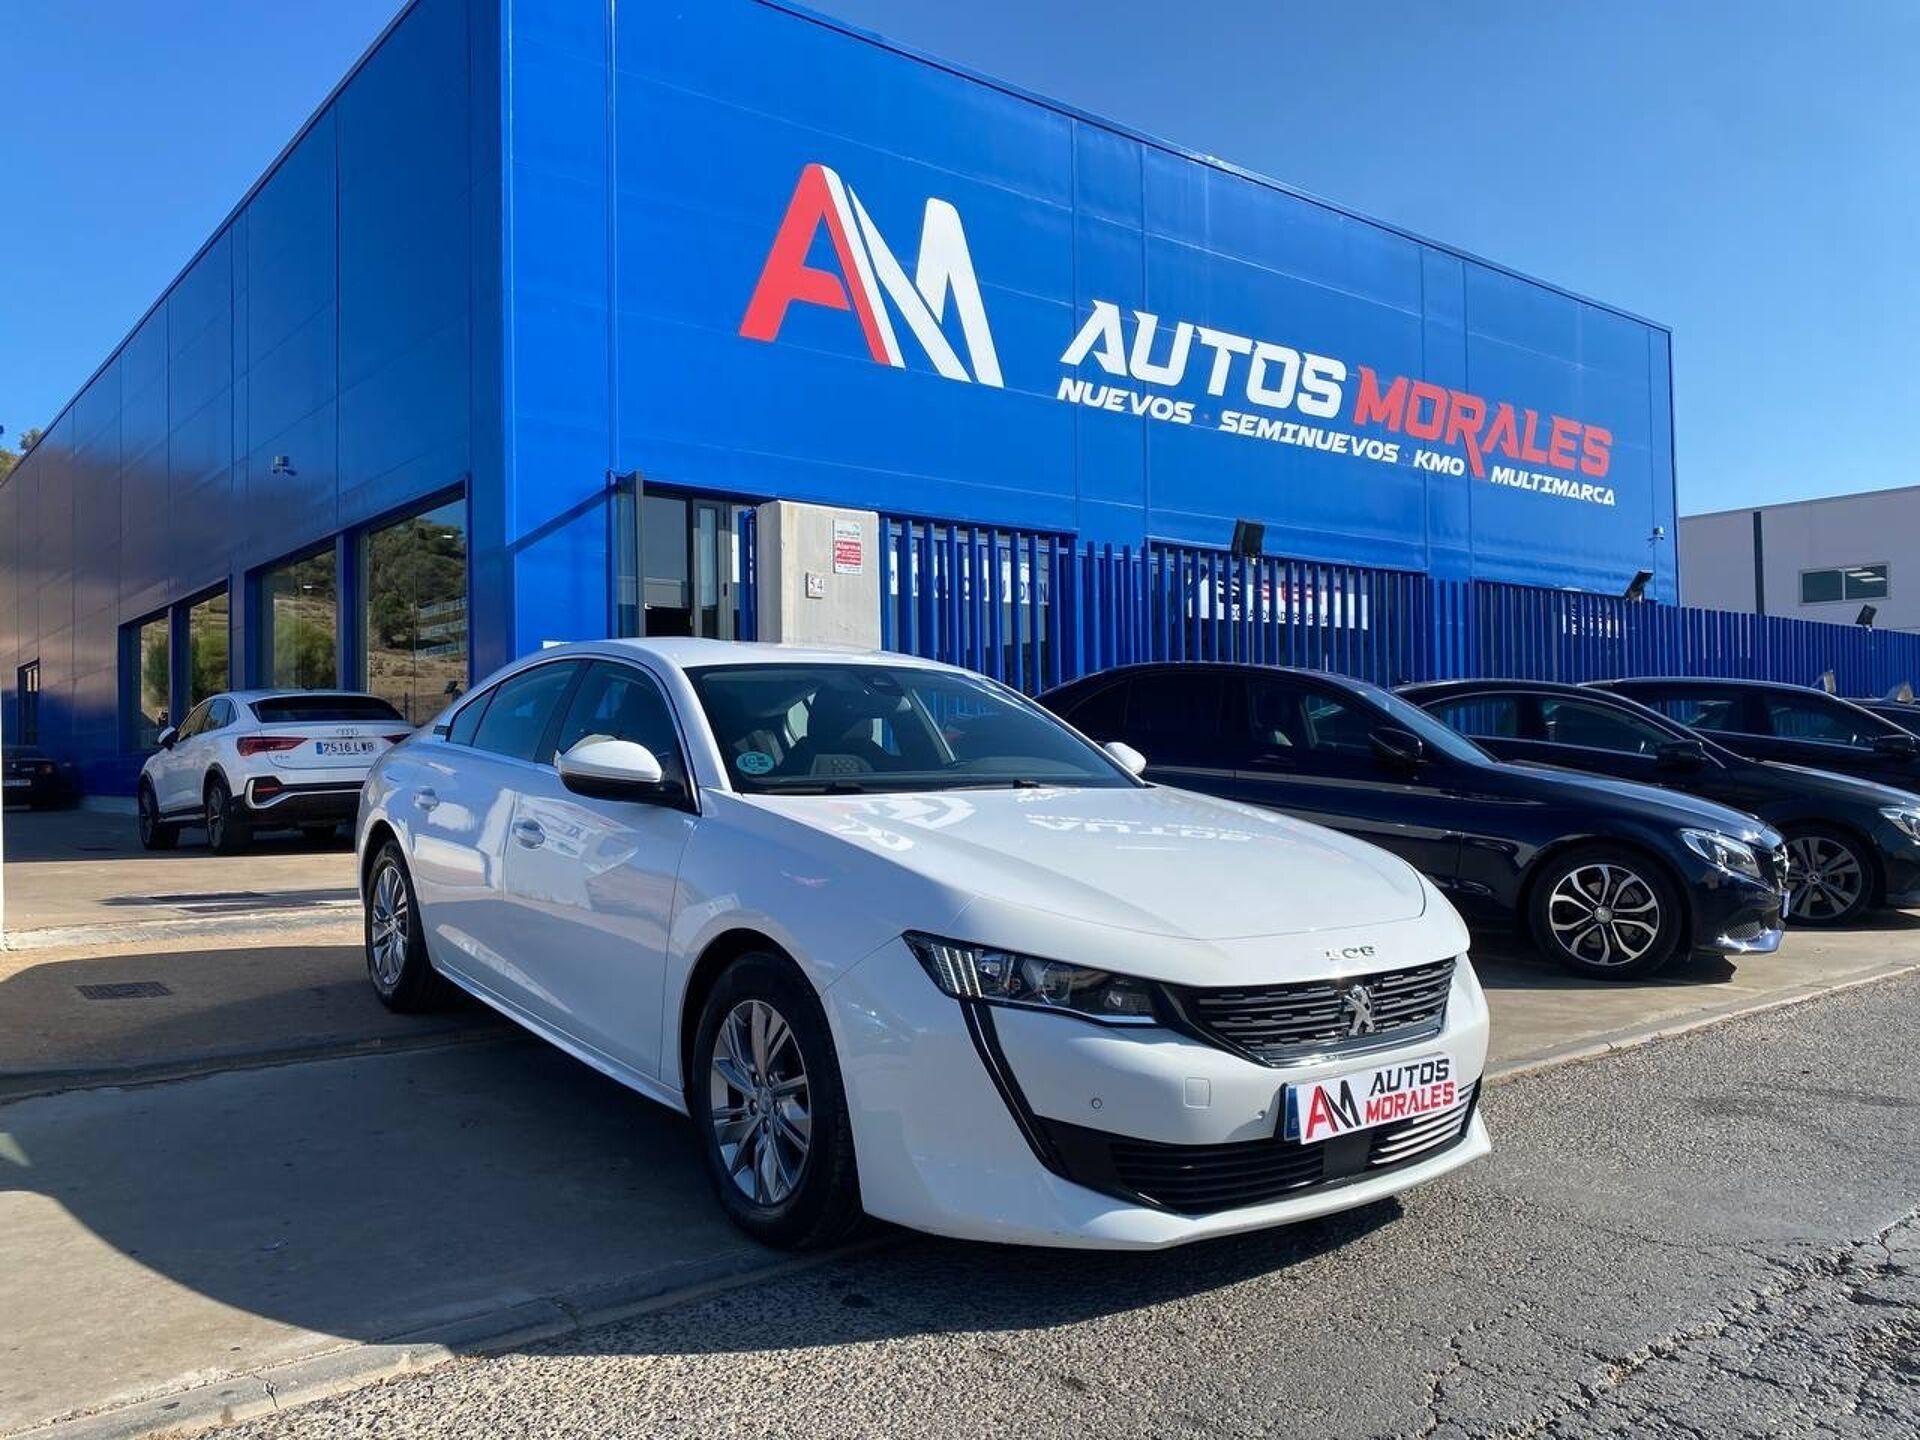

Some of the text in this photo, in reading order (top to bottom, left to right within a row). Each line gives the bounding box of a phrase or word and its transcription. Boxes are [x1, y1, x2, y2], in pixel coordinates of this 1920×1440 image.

[1060, 299, 1613, 479] AUTOS MORALES
[1056, 377, 1196, 425] NUEVOS
[1219, 410, 1400, 464] SEMINUEVOS
[1491, 465, 1616, 506] MULTIMARCA
[323, 742, 352, 753] 7516
[1365, 1081, 1455, 1125] MORALES
[1369, 1058, 1450, 1097] AUTOS
[1305, 1079, 1363, 1140] AM
